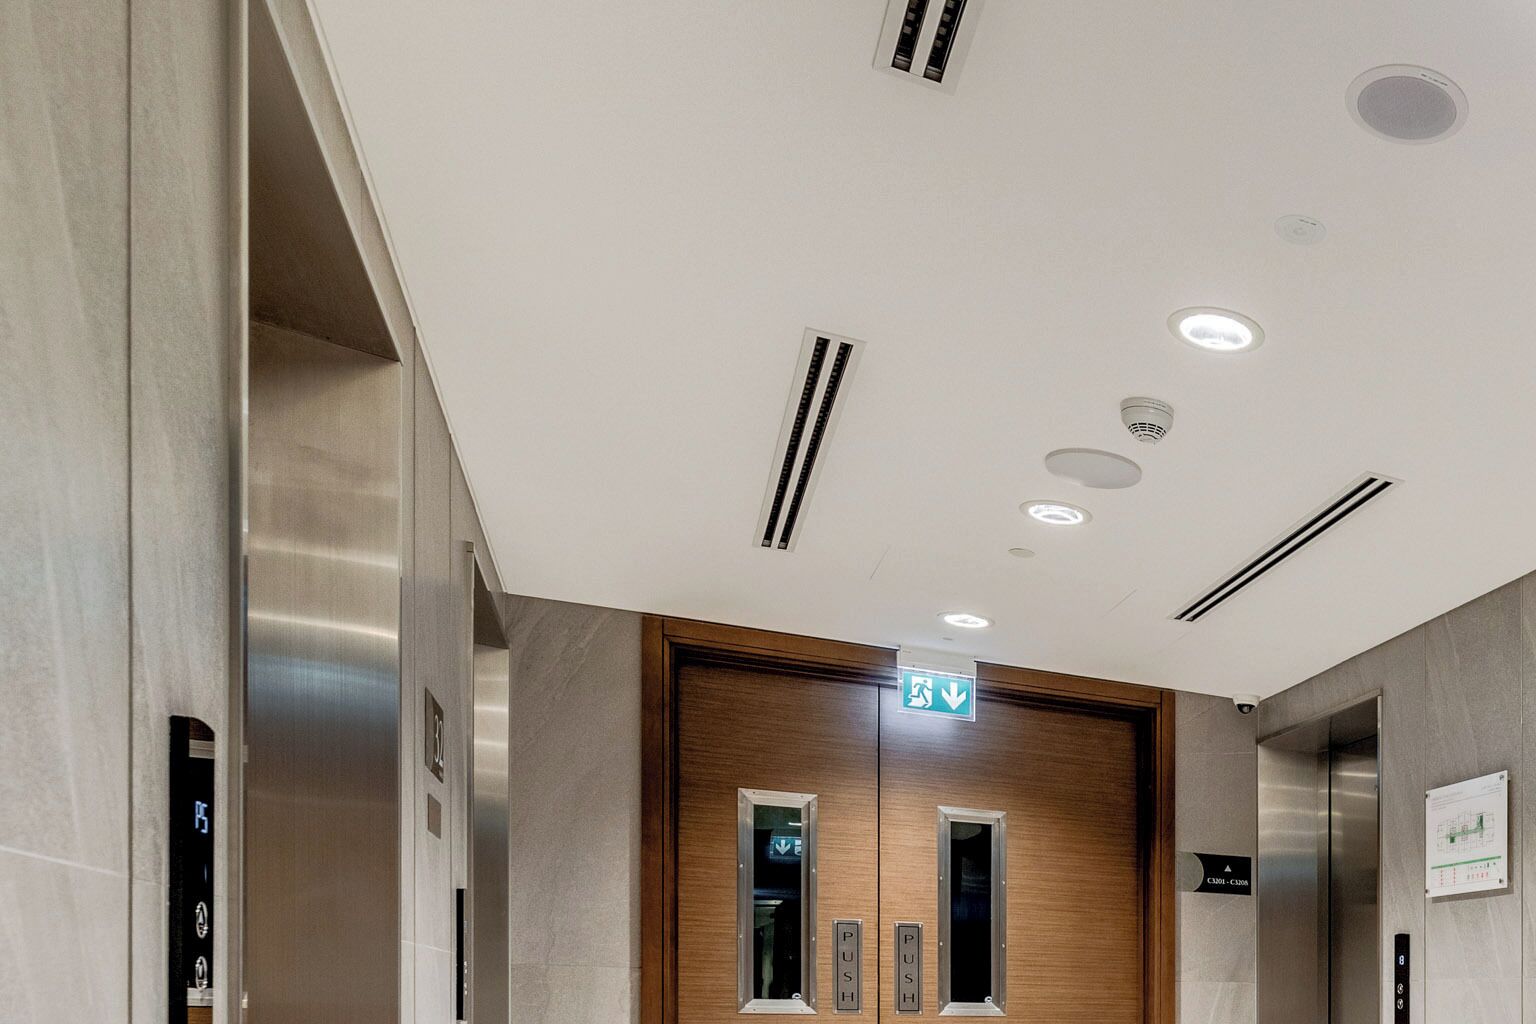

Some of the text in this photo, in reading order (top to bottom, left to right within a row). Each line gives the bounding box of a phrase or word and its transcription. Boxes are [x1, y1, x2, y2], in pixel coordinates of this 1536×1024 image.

[434, 714, 444, 768] 32
[195, 800, 208, 834] P5
[842, 931, 854, 1002] PUSH
[903, 934, 915, 1003] PUSH
